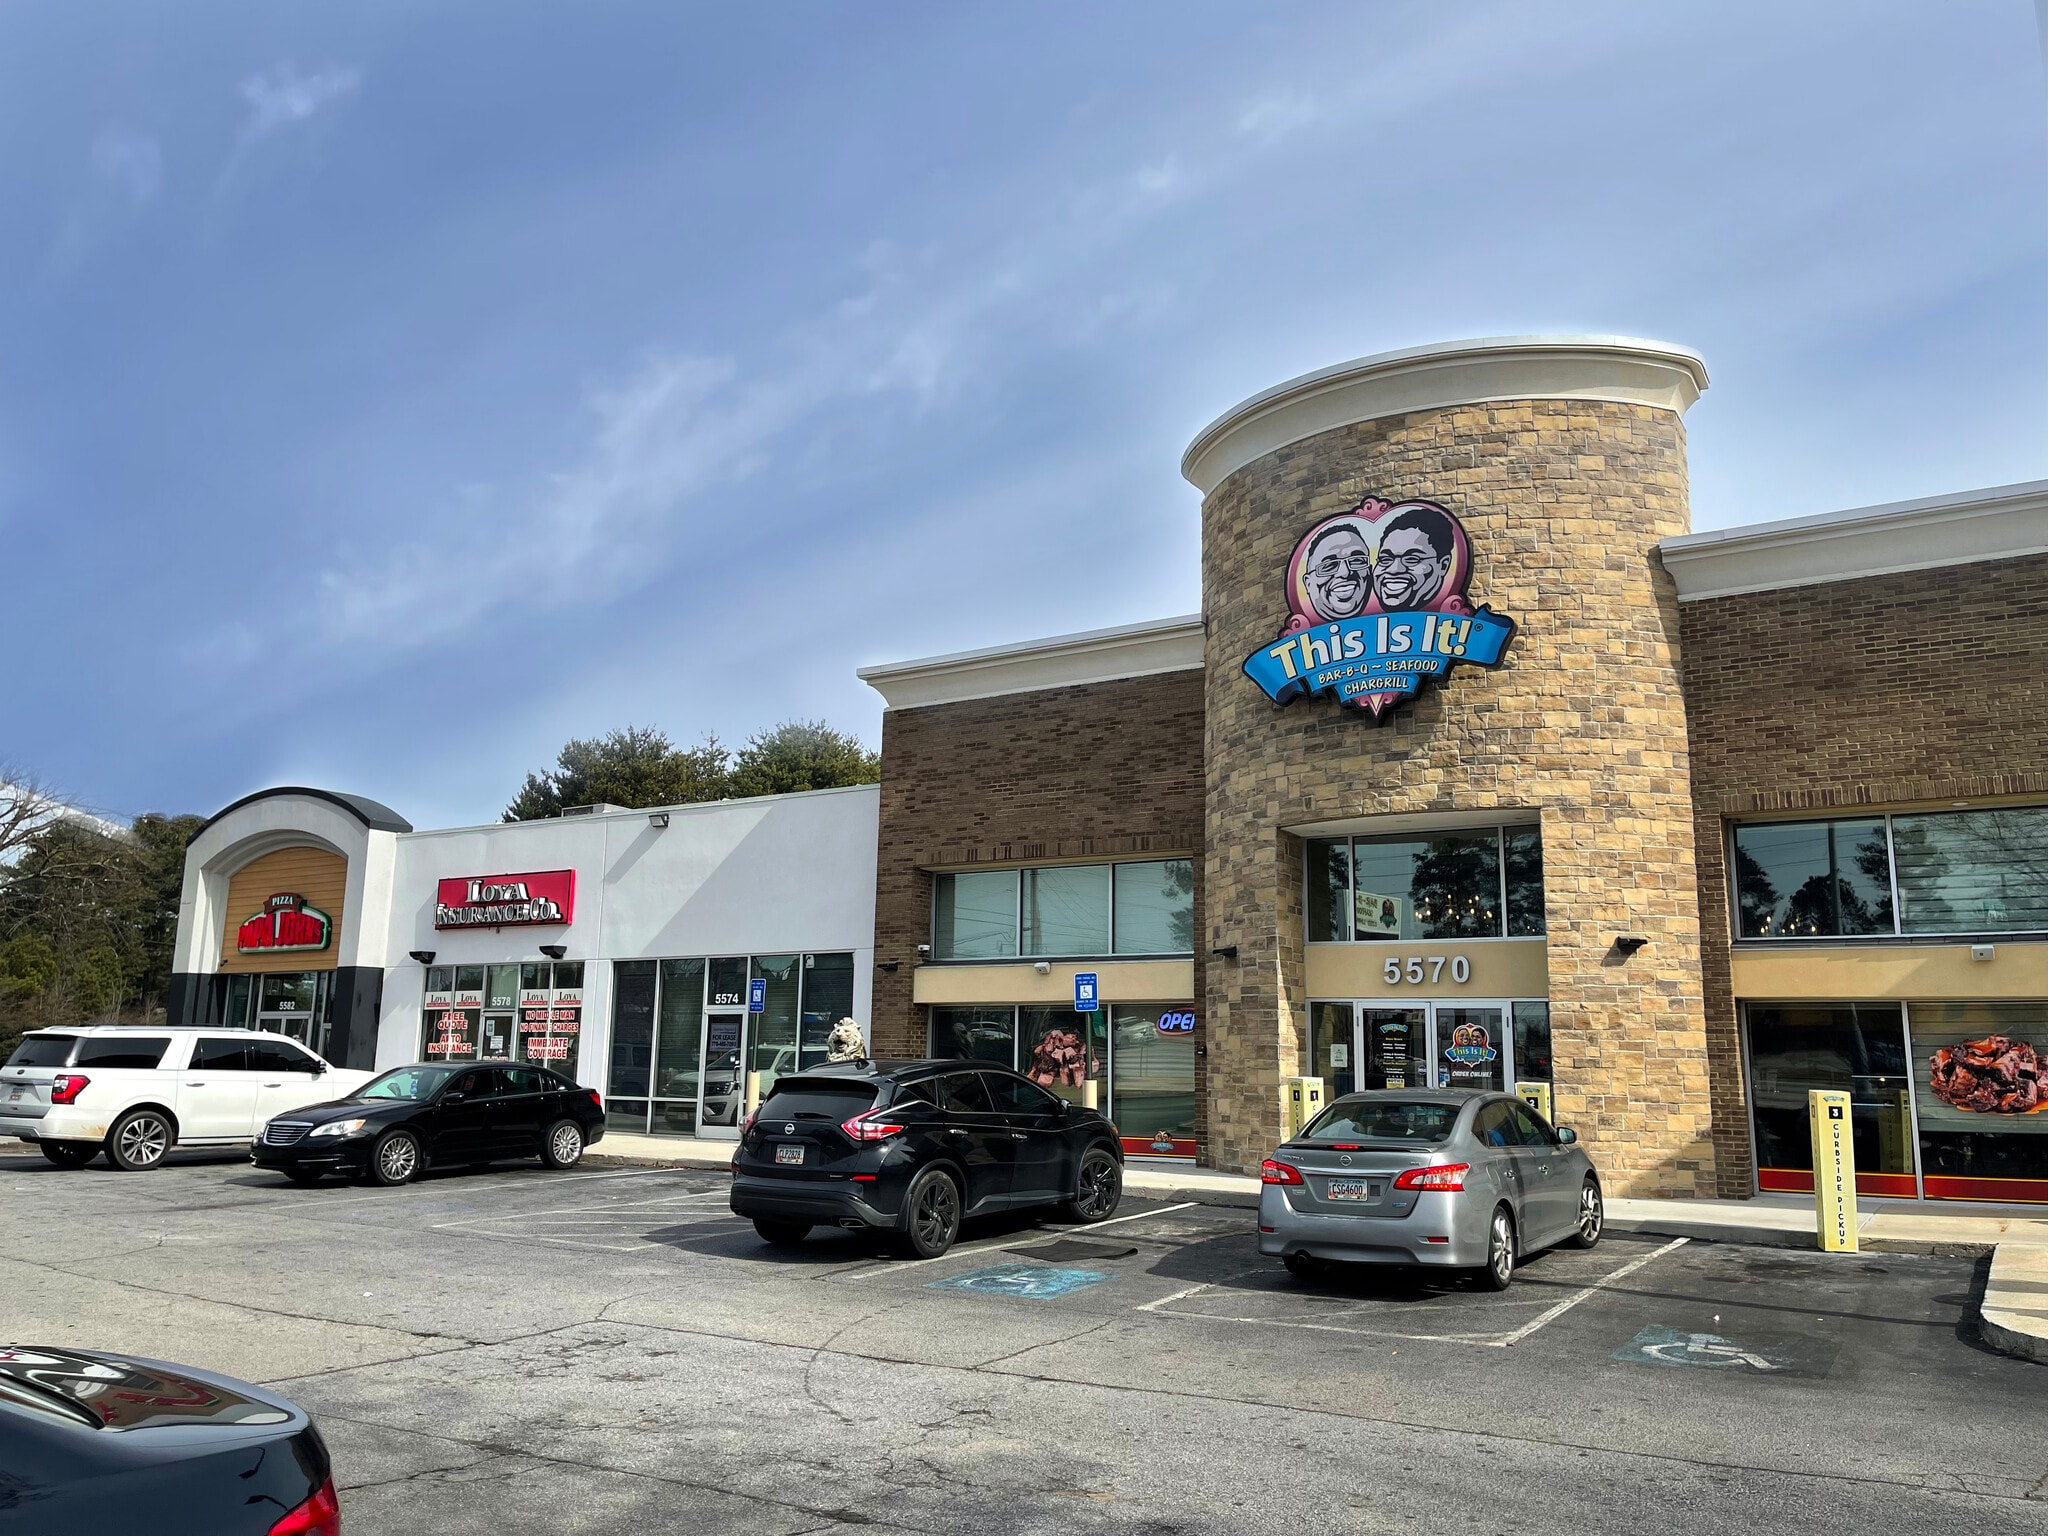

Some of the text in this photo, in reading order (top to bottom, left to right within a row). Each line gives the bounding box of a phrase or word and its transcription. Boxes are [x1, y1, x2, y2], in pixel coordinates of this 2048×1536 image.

[1270, 616, 1472, 680] This Is It!
[1318, 660, 1439, 684] BAR-B-Q SEAFOOD
[1344, 678, 1410, 697] CHARGRILL
[272, 896, 293, 906] PIZZA
[237, 911, 324, 949] PAPA JOHNS
[1383, 955, 1470, 985] 5570
[491, 996, 511, 1006] 5578
[715, 993, 739, 1005] 5574
[526, 1011, 535, 1020] NO
[560, 1010, 575, 1020] MAN
[553, 1023, 579, 1032] CHARGES
[1452, 1047, 1470, 1057] This
[1471, 1047, 1478, 1055] Is
[1832, 1108, 1839, 1117] 3
[1833, 1123, 1842, 1192] CURBSIDE
[1332, 1184, 1363, 1195] CSG4600
[1837, 1196, 1845, 1245] PICKUP
